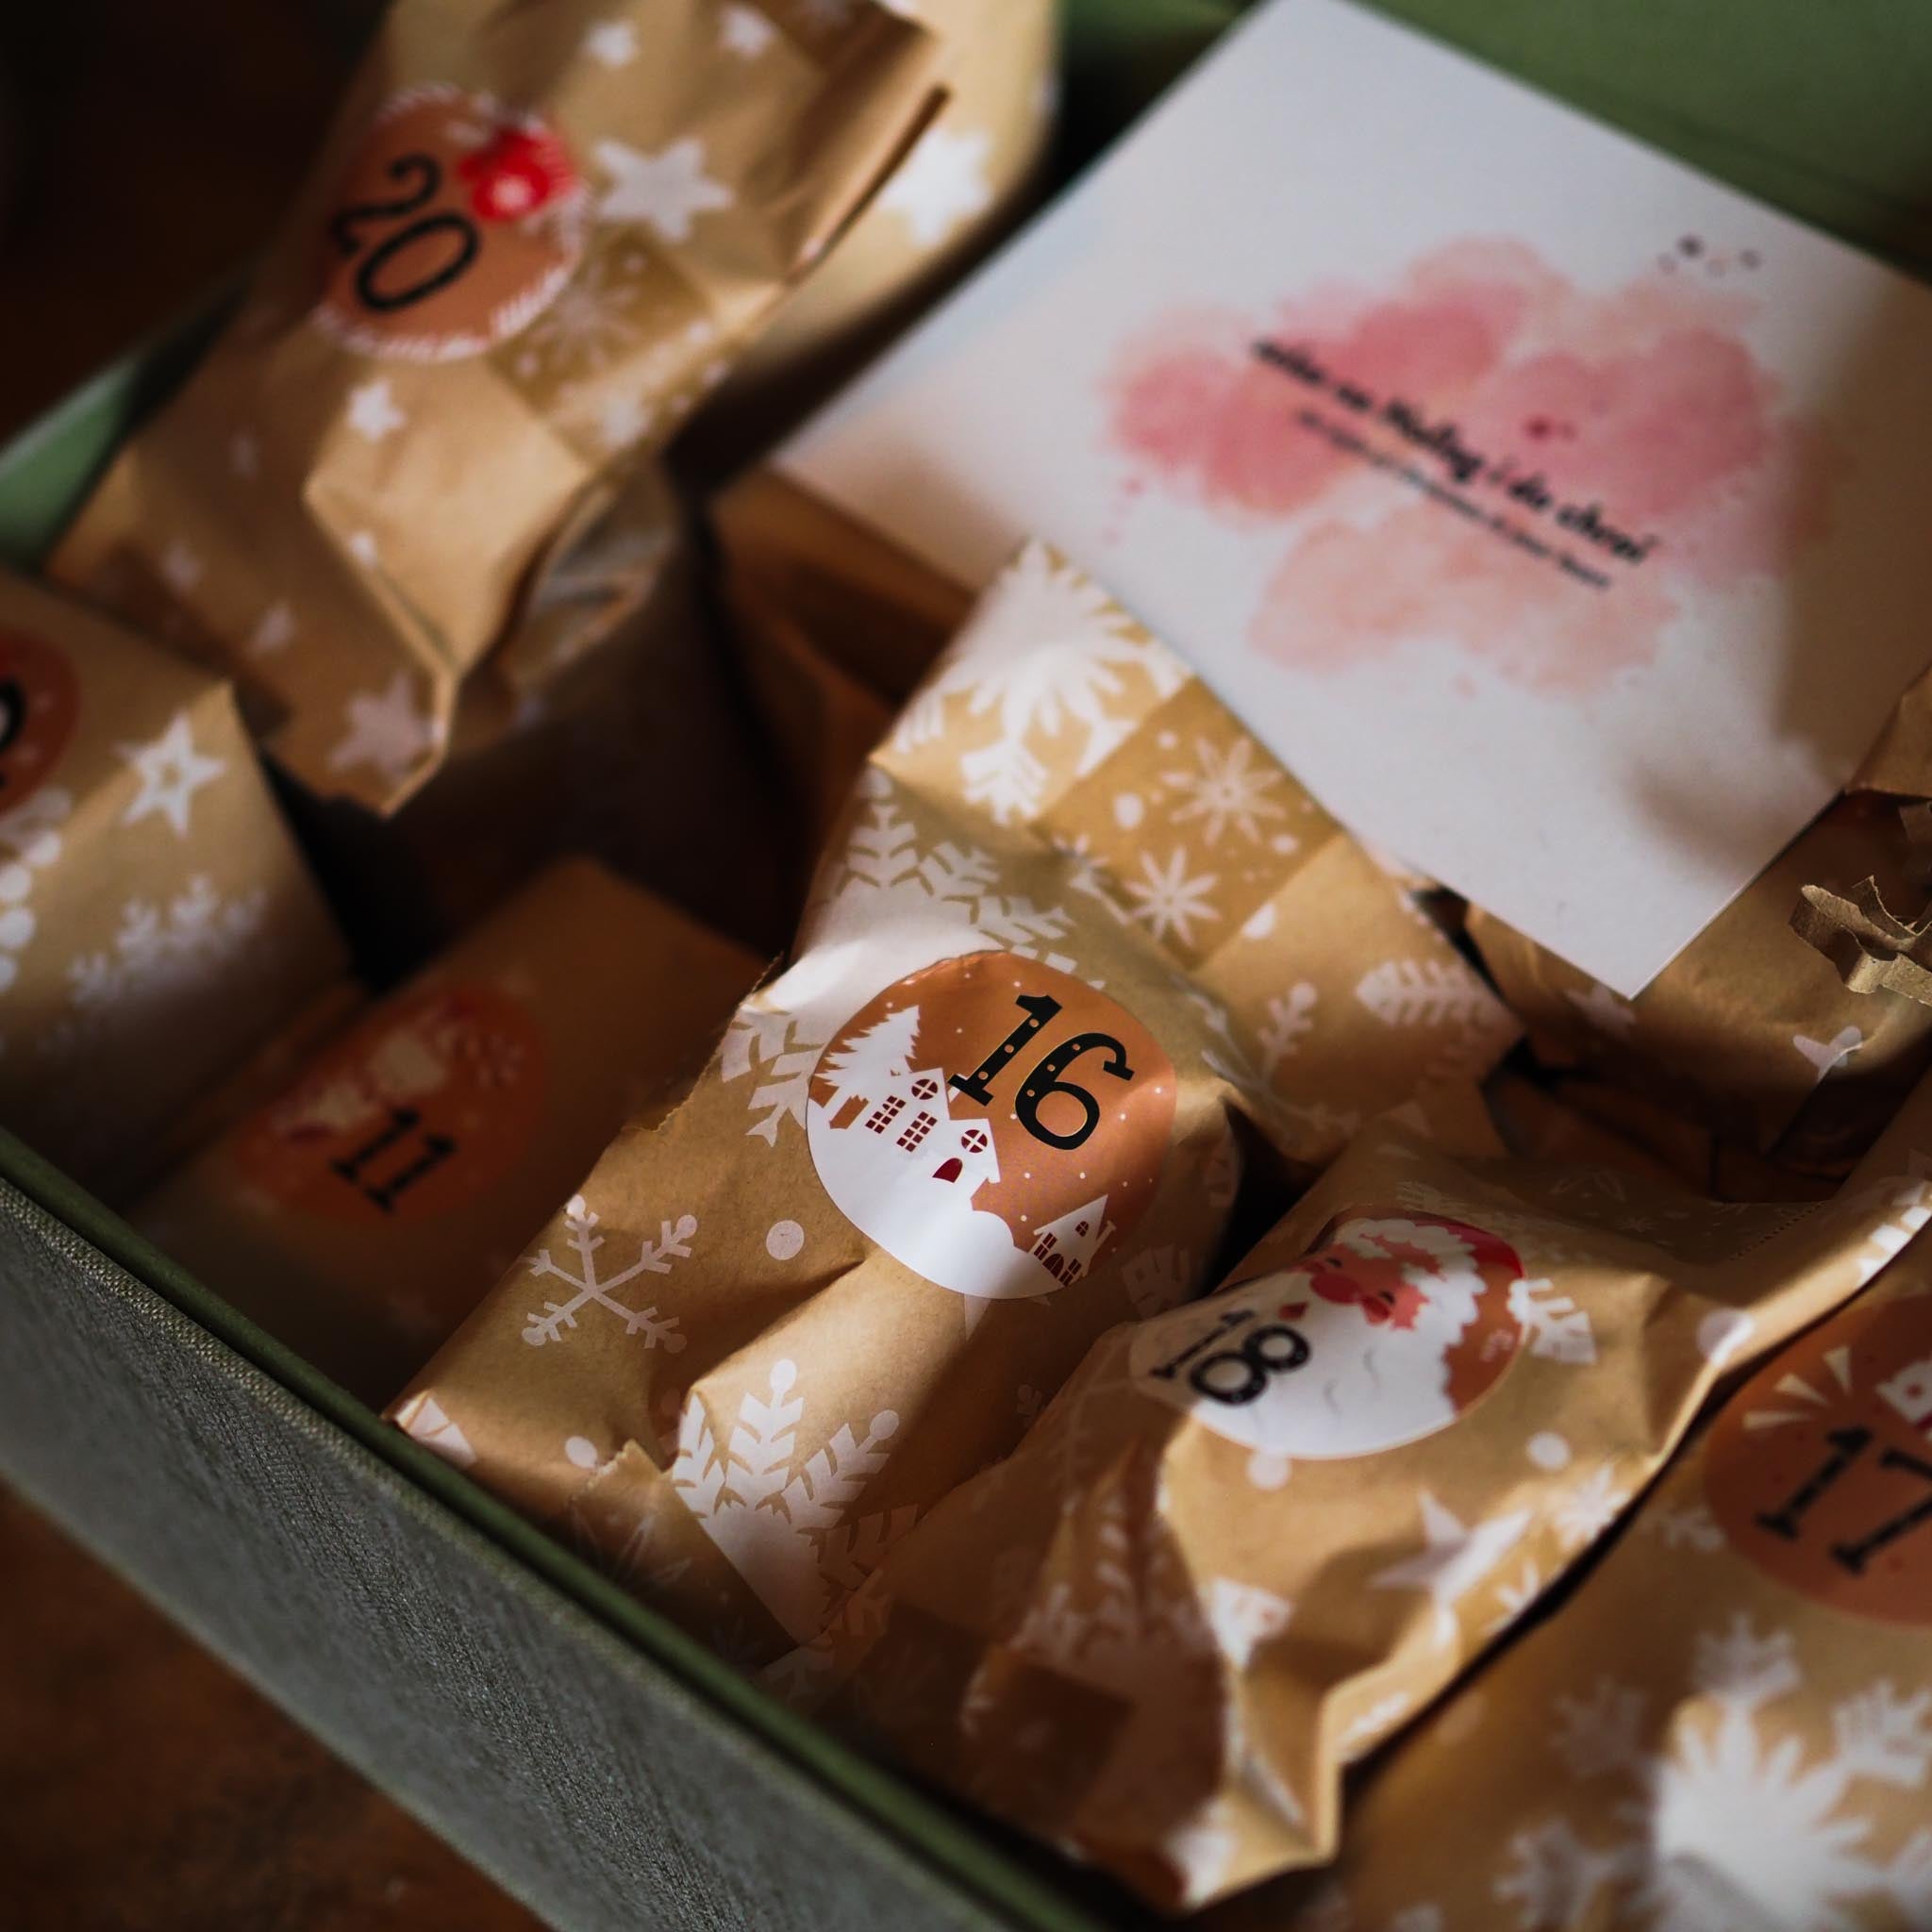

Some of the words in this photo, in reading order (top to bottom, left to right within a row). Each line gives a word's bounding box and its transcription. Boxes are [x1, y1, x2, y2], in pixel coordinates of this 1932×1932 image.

[329, 150, 481, 313] 20
[947, 994, 1135, 1150] 16
[329, 1107, 458, 1214] 11
[1148, 1308, 1311, 1407] 18
[1755, 1427, 1932, 1576] 17
